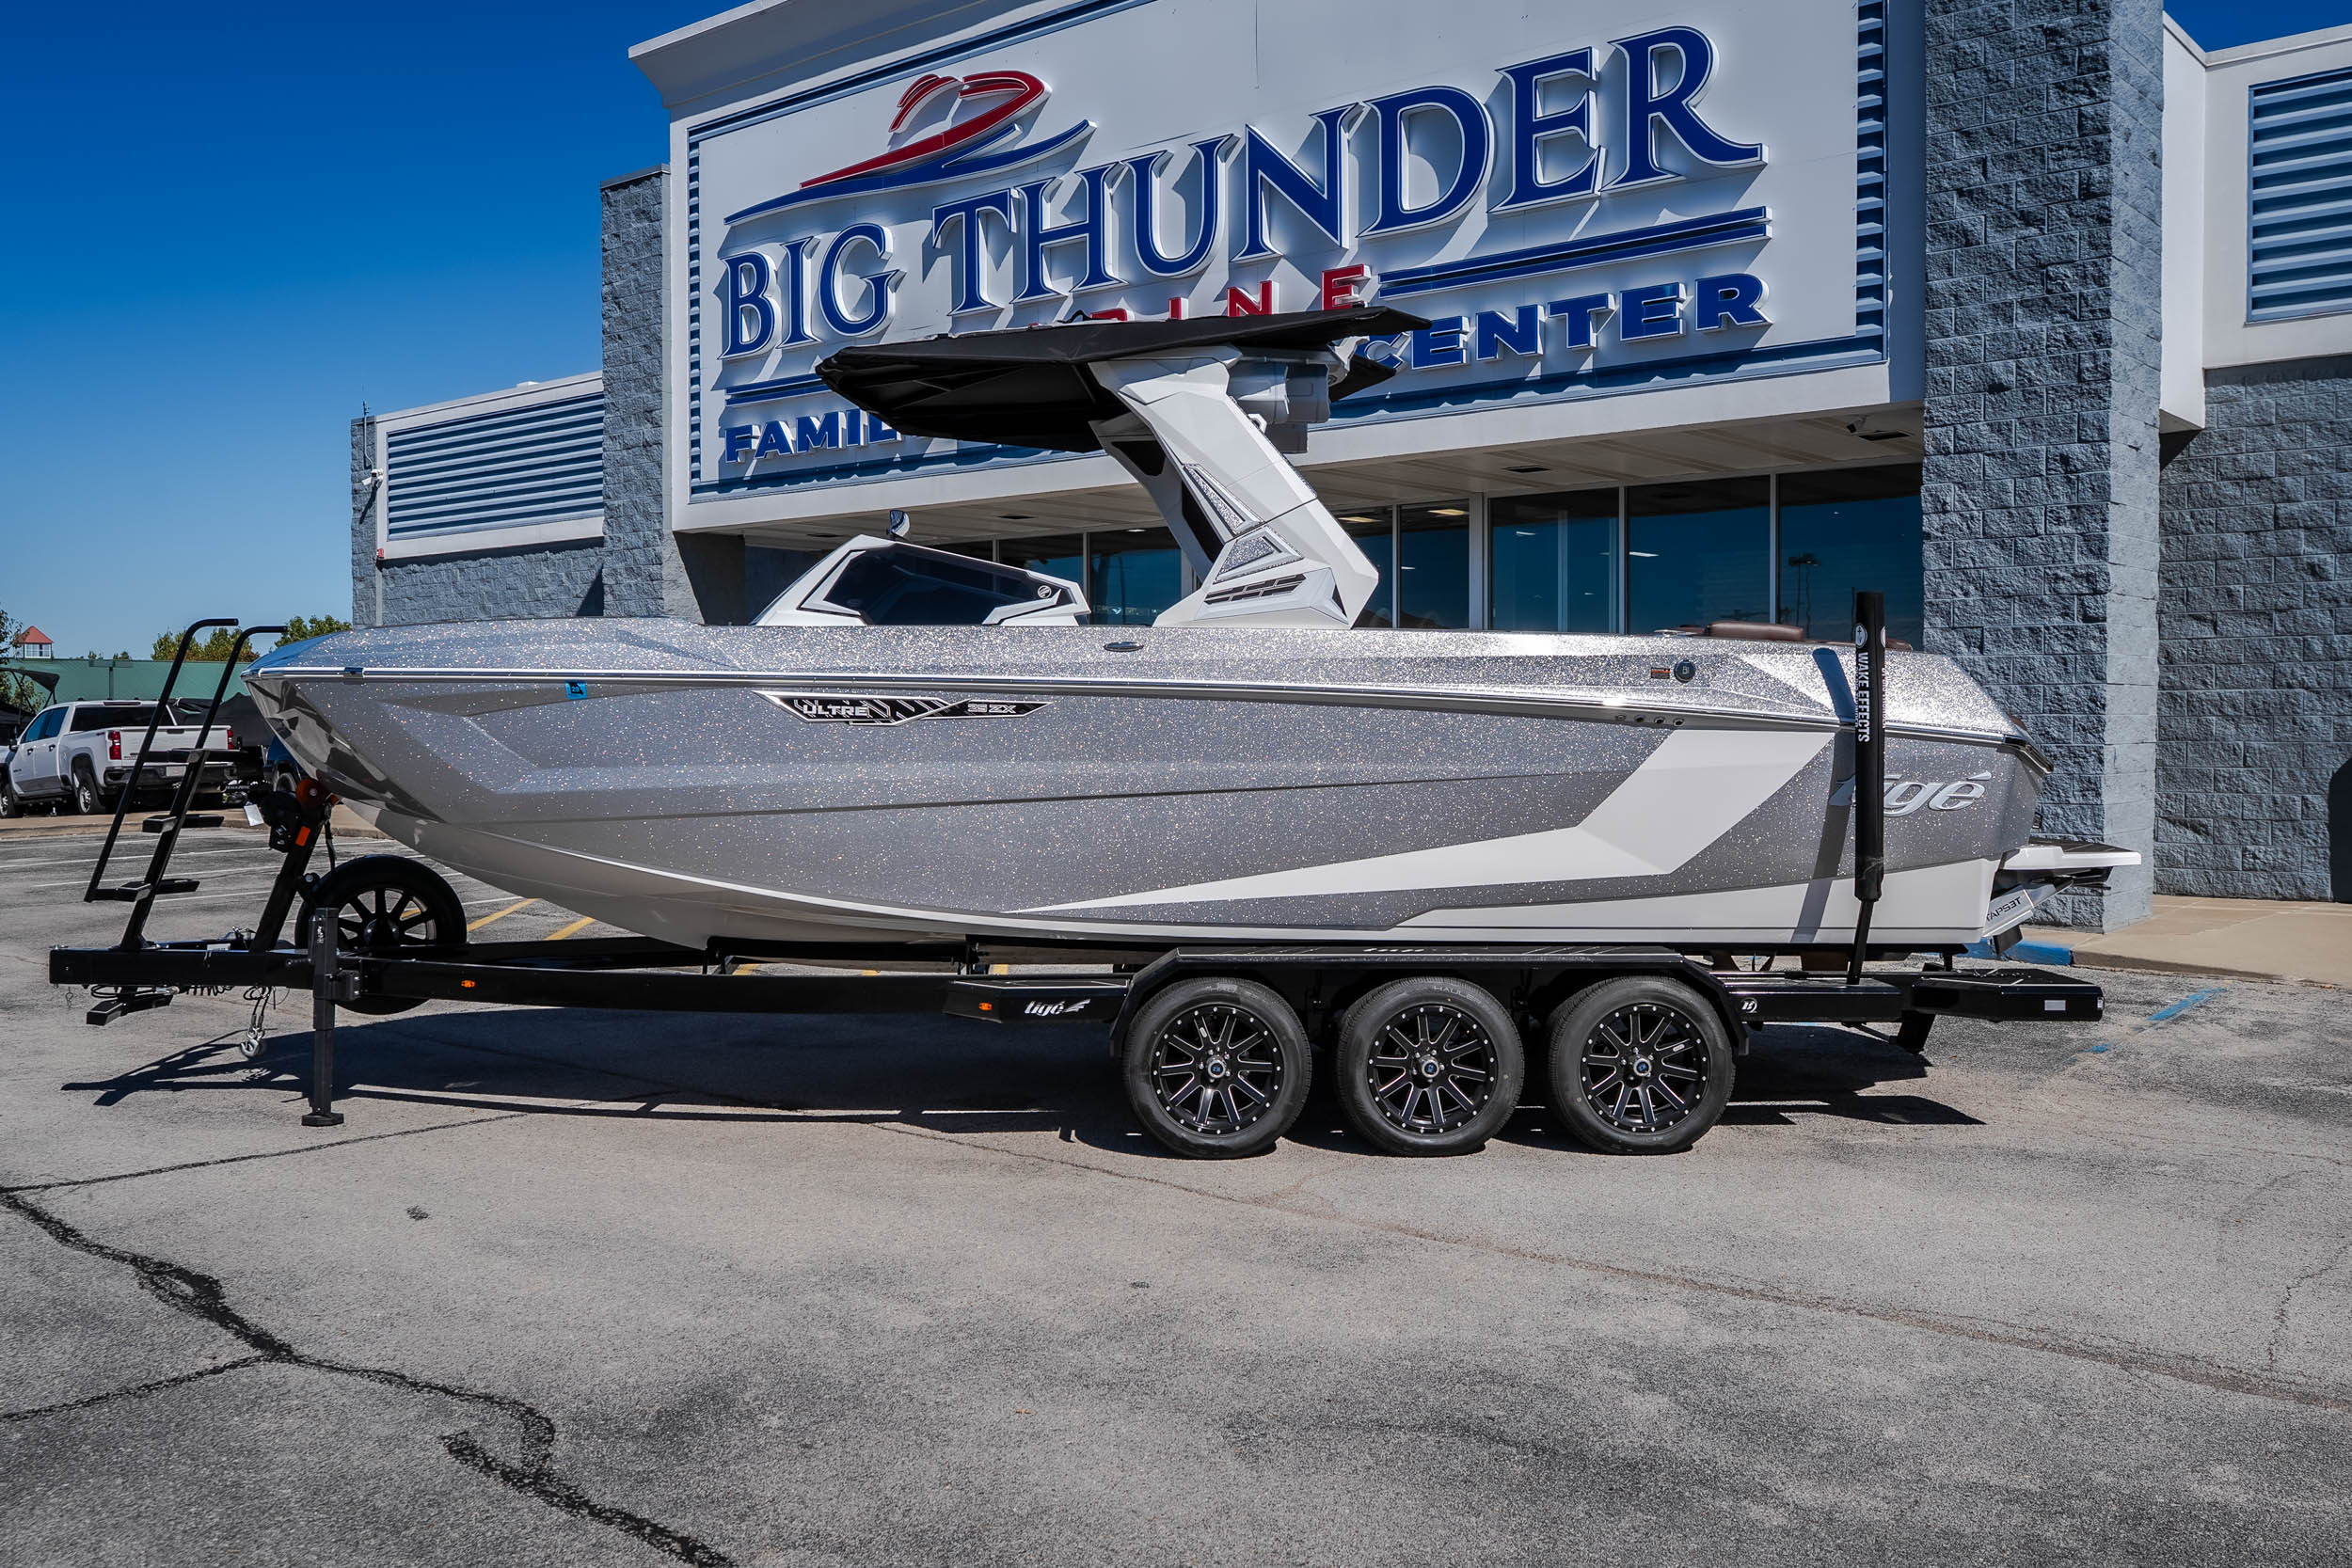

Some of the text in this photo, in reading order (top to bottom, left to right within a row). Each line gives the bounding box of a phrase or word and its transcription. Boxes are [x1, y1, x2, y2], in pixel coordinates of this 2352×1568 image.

[719, 25, 1766, 359] BIG THUNDER
[1858, 652, 1870, 742] WAKE EFFECTS
